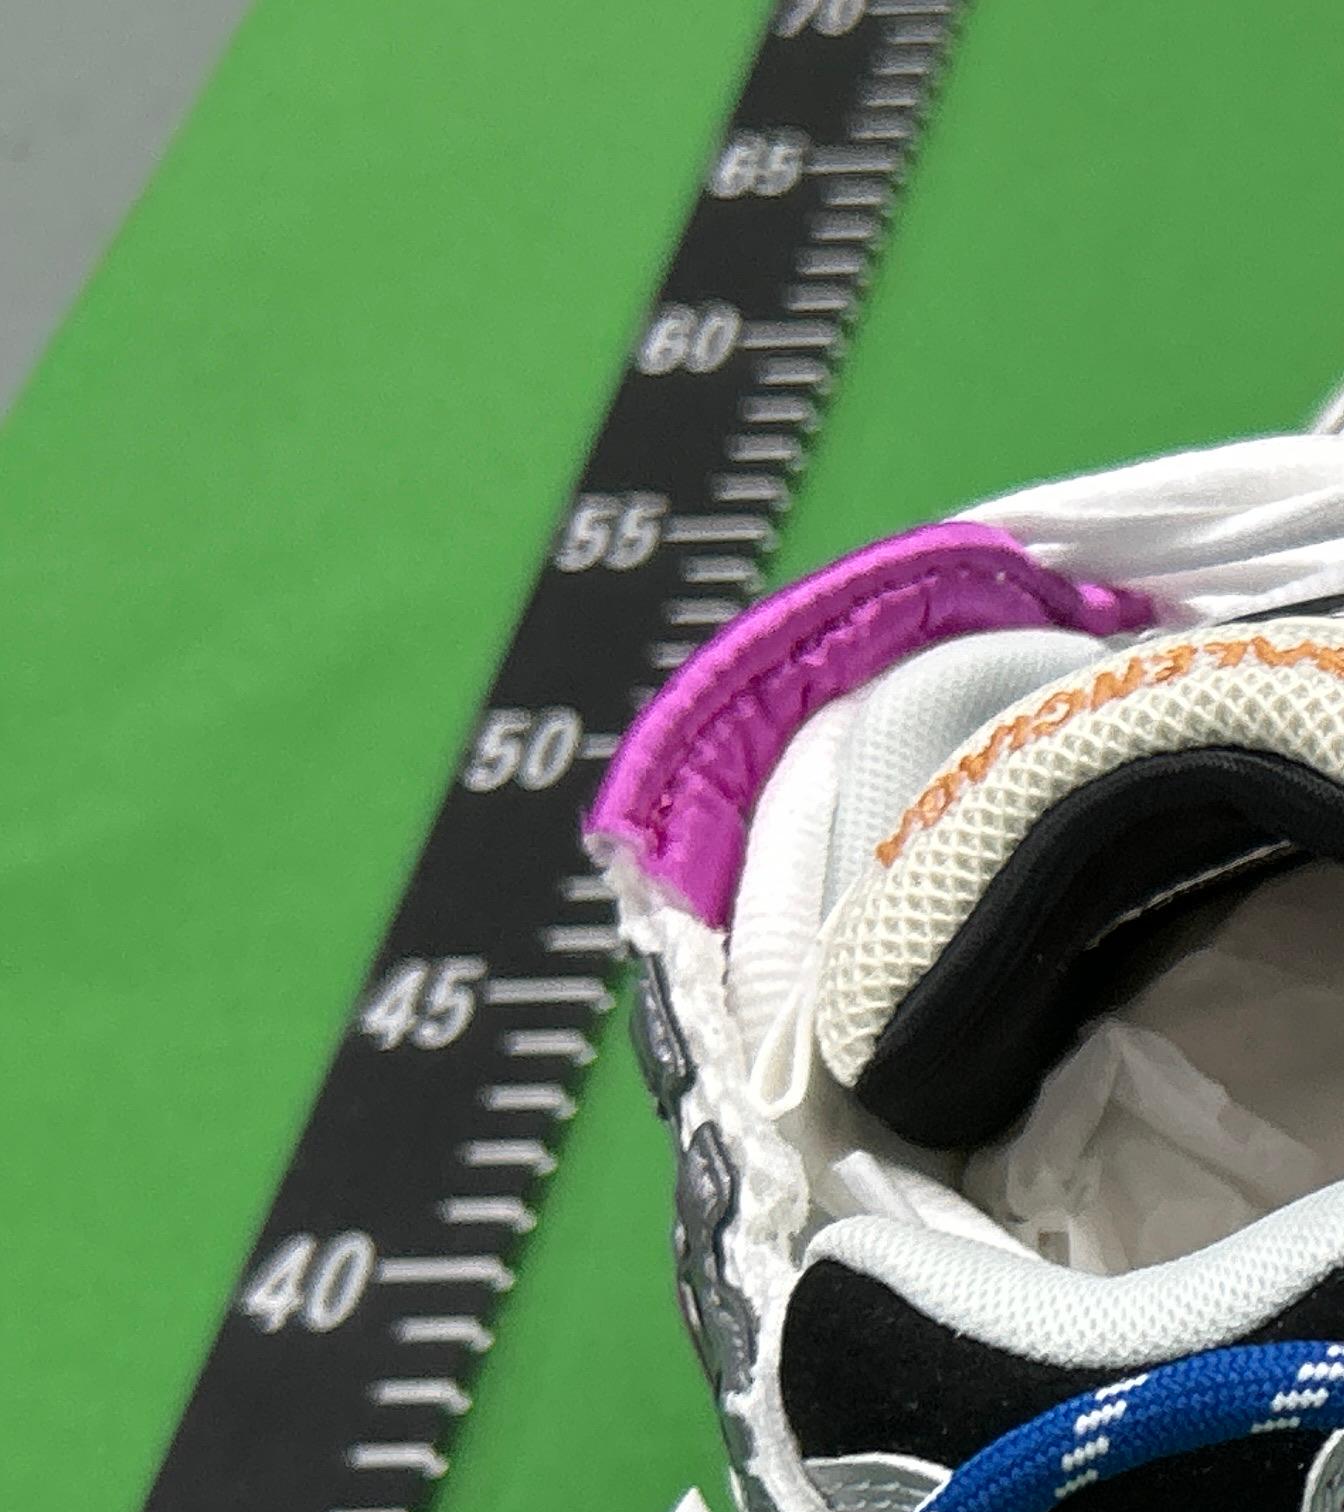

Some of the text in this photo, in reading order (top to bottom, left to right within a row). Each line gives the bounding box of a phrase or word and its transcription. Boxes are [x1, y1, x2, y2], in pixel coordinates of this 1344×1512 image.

[704, 130, 802, 198] 65
[636, 303, 740, 374] 60
[555, 493, 668, 571] 55
[463, 706, 581, 792] 50
[361, 956, 485, 1050] 45
[242, 1231, 374, 1332] 40
